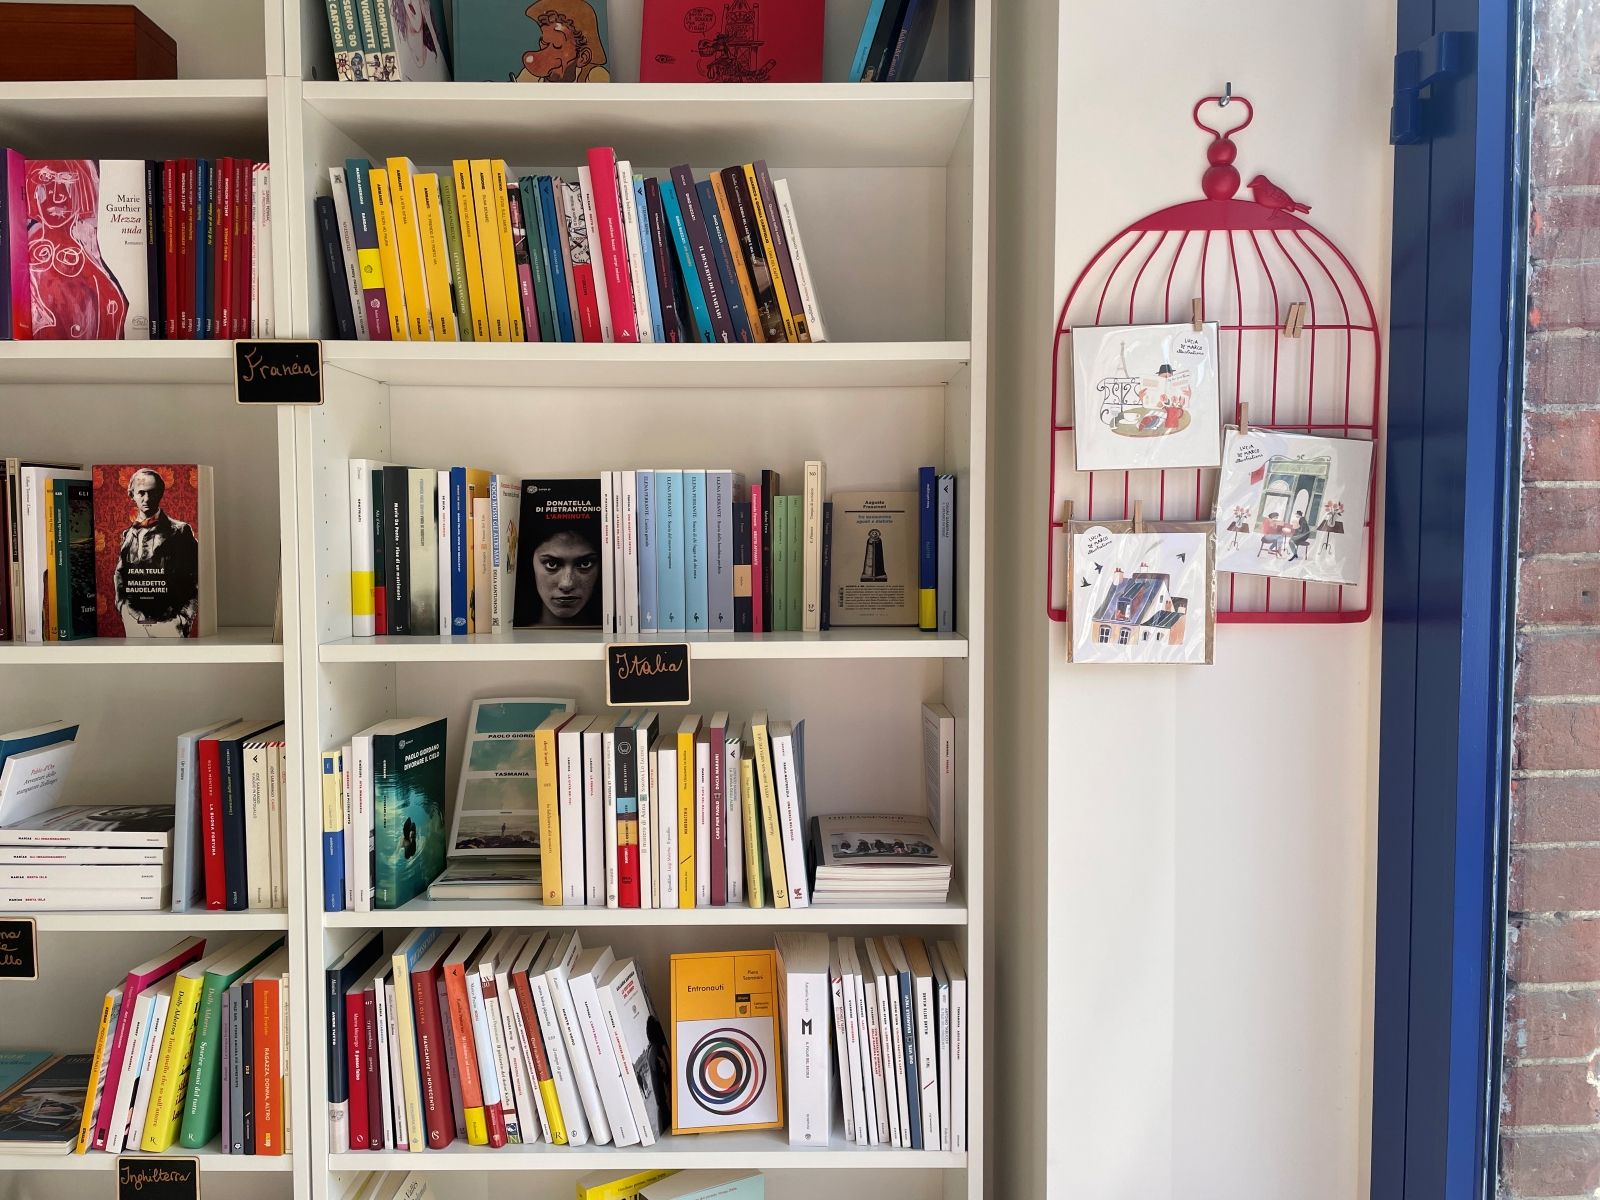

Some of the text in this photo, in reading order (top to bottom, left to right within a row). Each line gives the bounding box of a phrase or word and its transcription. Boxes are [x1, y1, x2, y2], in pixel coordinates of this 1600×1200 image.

[329, 3, 343, 47] CARTOON
[342, 0, 357, 47] SEGNO '80
[360, 0, 376, 49] VIGNETTE
[106, 204, 141, 213] Gauthier
[117, 195, 140, 203] Marie
[749, 177, 758, 197] GIANRICO
[755, 201, 763, 219] GIORGIA
[759, 219, 769, 244] CAROFIGLIO
[110, 214, 141, 224] Mezza
[688, 205, 696, 221] BUZZATI
[678, 227, 686, 244] BUZZATI
[715, 226, 723, 244] BUZZATI
[700, 253, 712, 281] DESERTO
[707, 282, 715, 293] DEI
[710, 292, 722, 319] TARTARI
[242, 346, 319, 382] Francia
[145, 567, 165, 575] TEULÉ
[616, 651, 683, 679] Italia
[403, 757, 425, 771] DIVORARE
[428, 751, 440, 761] CIELO
[404, 743, 440, 762] PAOLO GIORDANO
[416, 982, 425, 1005] MARILÙ
[687, 984, 725, 993] Entronauti
[102, 1006, 110, 1024] KEEGAN
[170, 991, 185, 1035] Dolly Alderton
[201, 987, 215, 1036] Dolly Alderton
[562, 1008, 571, 1026] NIENTE
[568, 1033, 576, 1046] VERO
[801, 1018, 813, 1035] M
[166, 1037, 175, 1052] Tutto
[422, 1035, 431, 1070] BIANCANEVE
[162, 1054, 171, 1074] quello
[497, 1048, 505, 1071] gabinetto
[501, 1077, 509, 1091] dottor
[160, 1075, 168, 1086] che
[191, 1041, 207, 1115] Sparire quasi del tutto
[426, 1077, 435, 1111] NOVECENTO
[152, 1095, 165, 1127] sull'amore
[120, 1165, 191, 1191] Inghilterra
